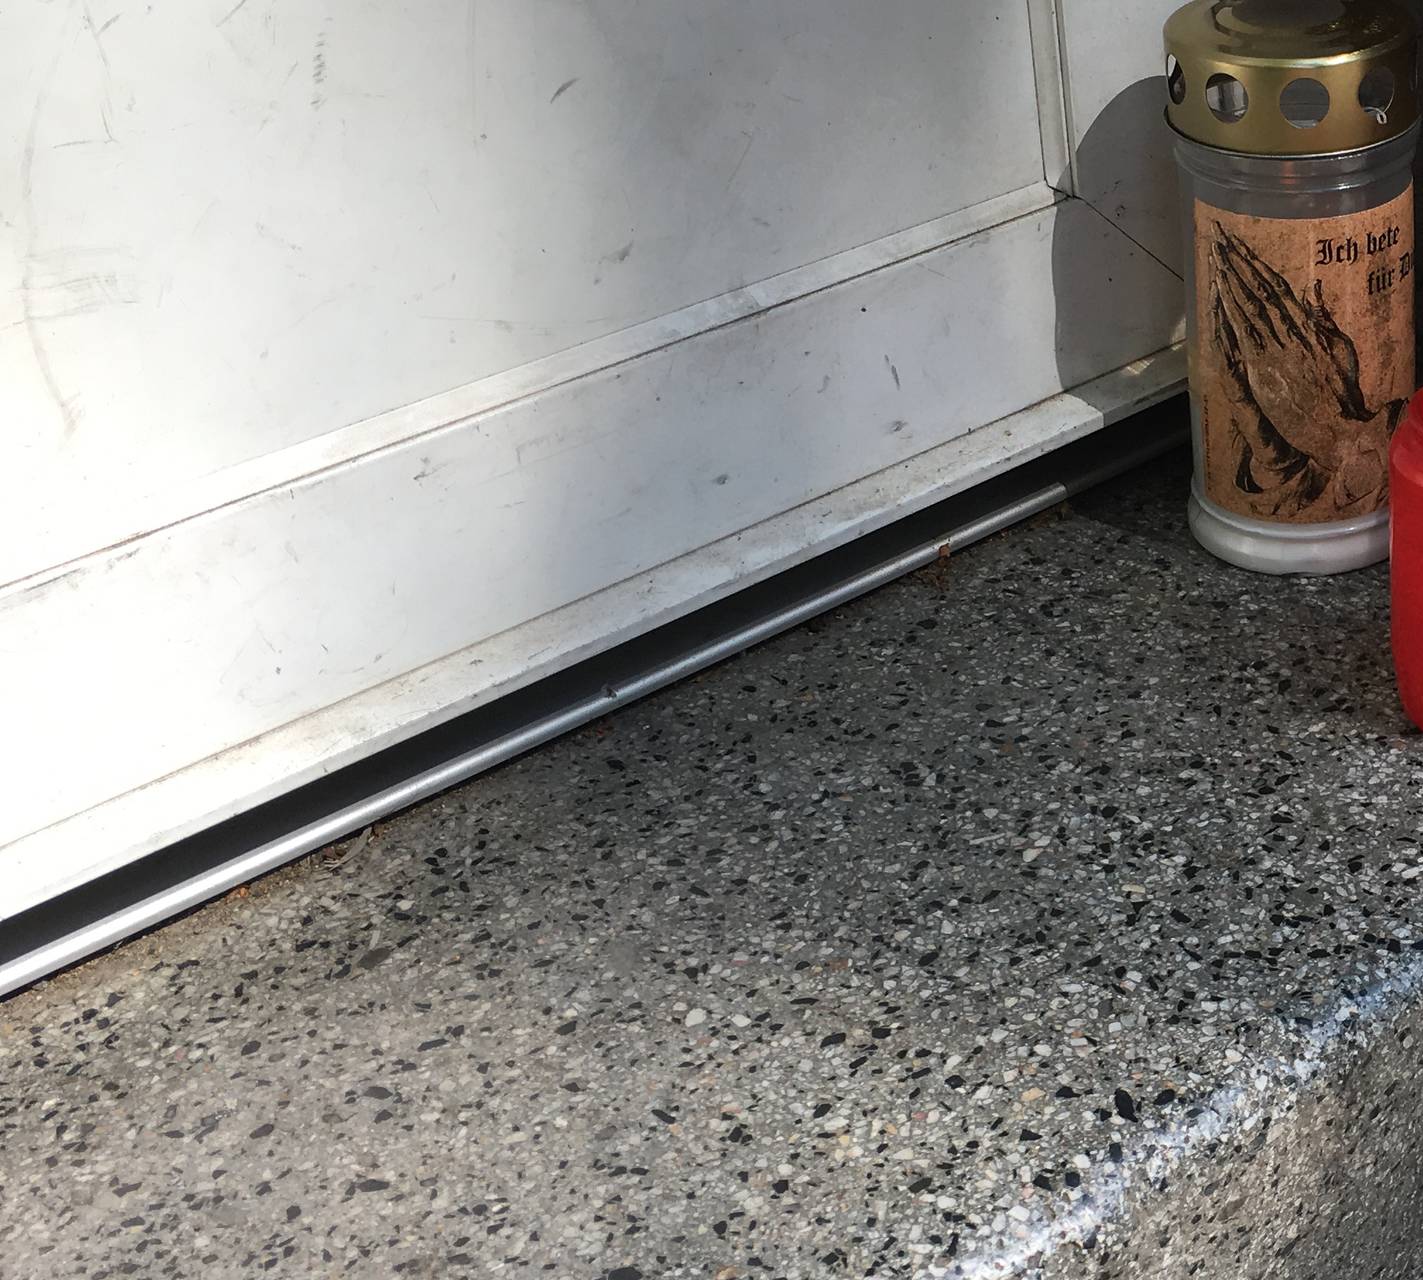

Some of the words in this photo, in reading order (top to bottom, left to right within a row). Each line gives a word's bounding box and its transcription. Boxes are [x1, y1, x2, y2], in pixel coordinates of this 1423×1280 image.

[1315, 237, 1358, 266] Ich
[1366, 226, 1400, 255] bete
[1367, 266, 1396, 295] für
